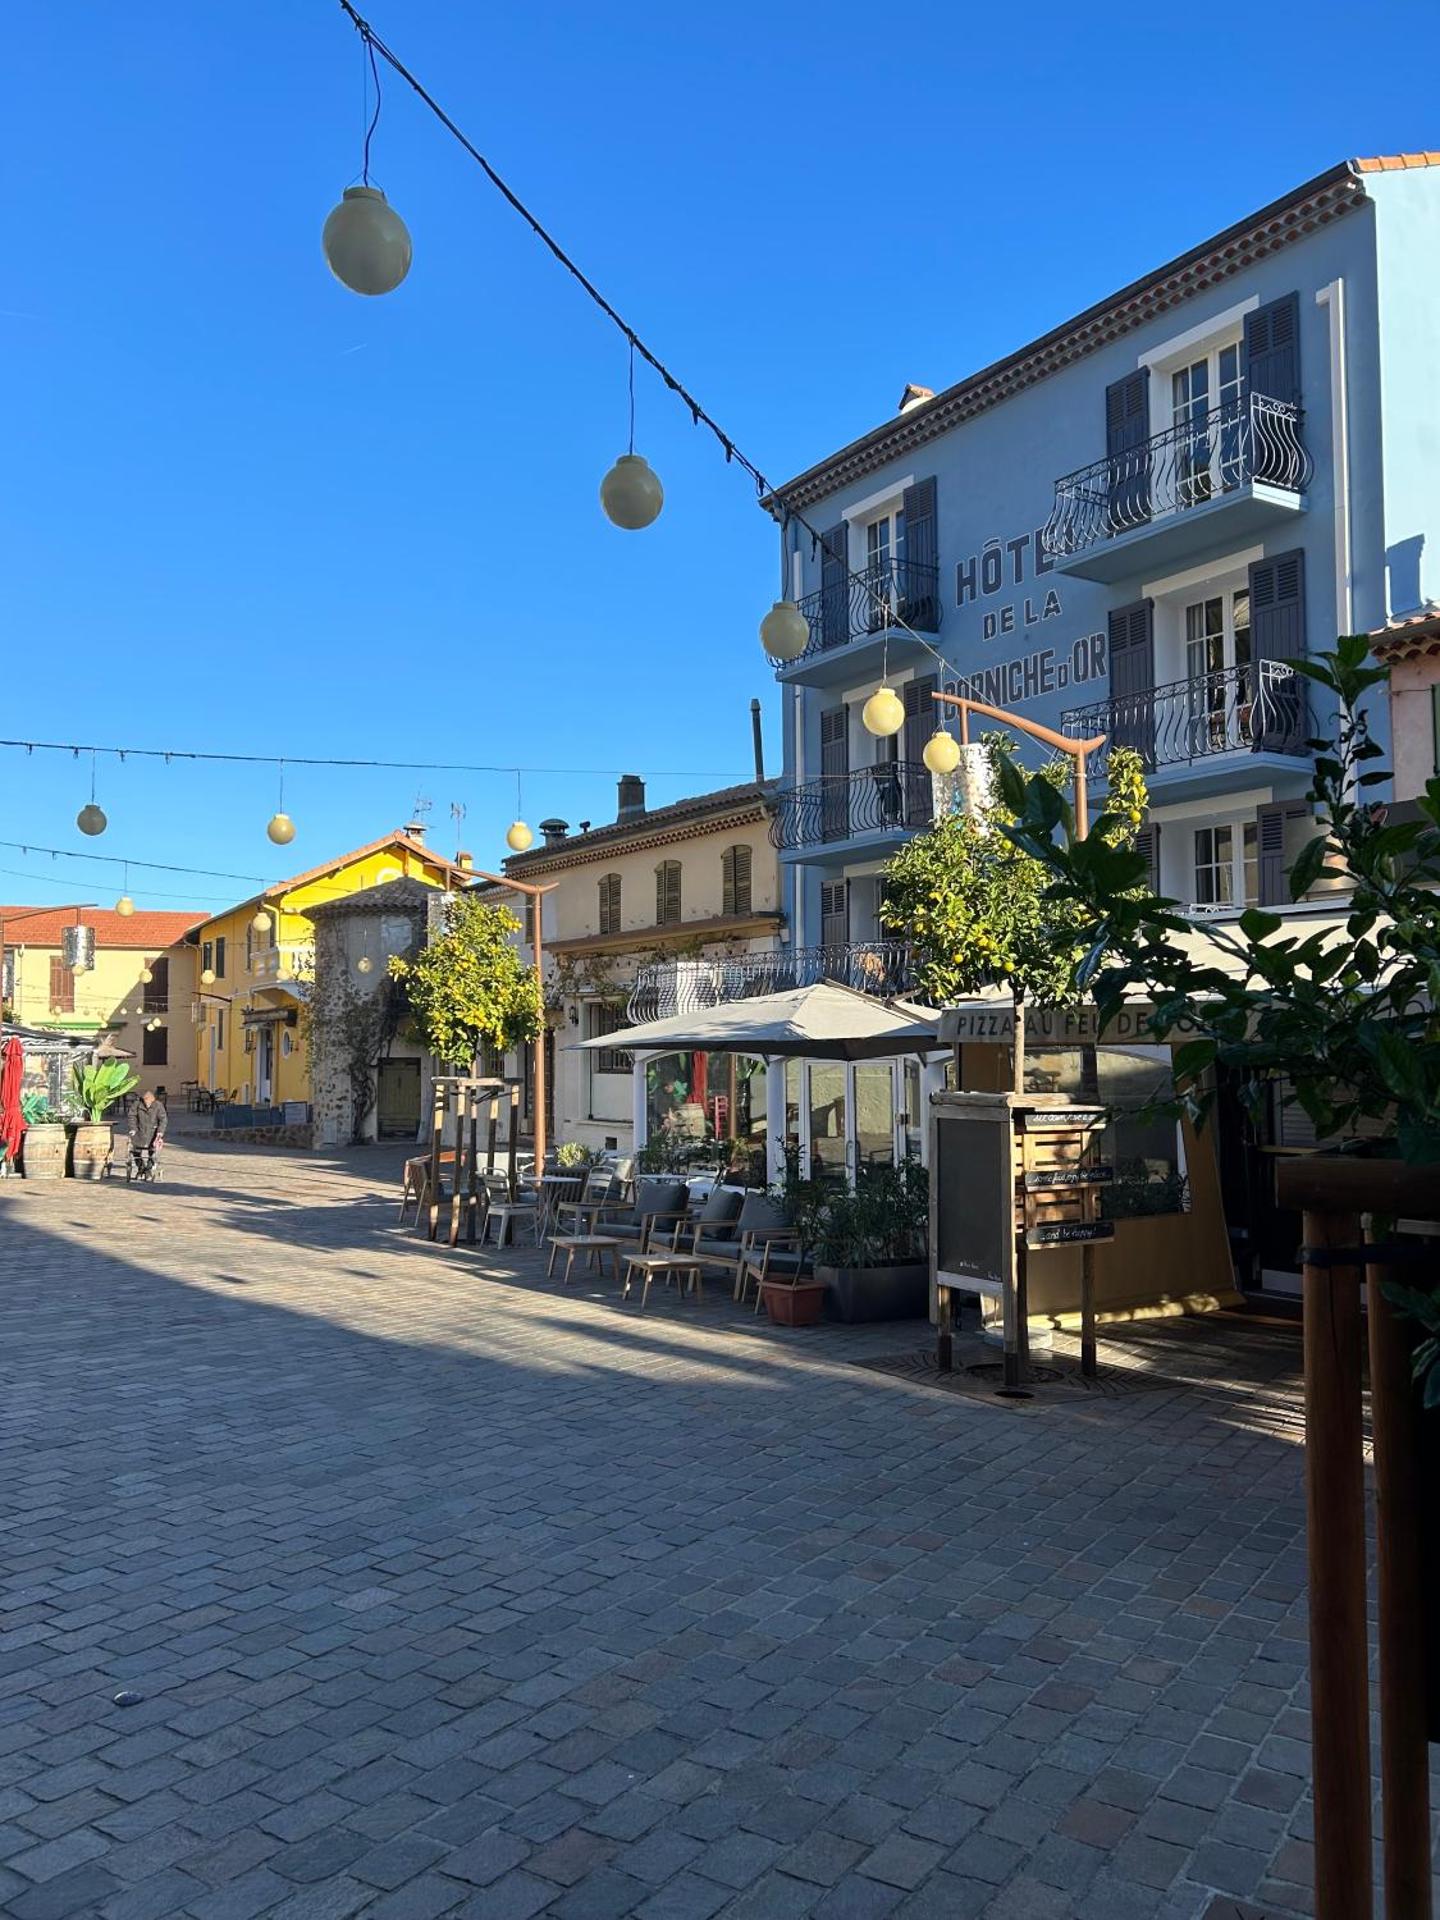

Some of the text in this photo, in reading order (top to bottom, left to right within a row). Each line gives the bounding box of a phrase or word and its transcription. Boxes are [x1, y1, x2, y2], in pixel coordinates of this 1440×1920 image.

[983, 589, 1062, 641] DE LA
[943, 648, 1056, 723] CORNICHE
[957, 1014, 1013, 1036] PIZZA
[1024, 1012, 1054, 1036] AU
